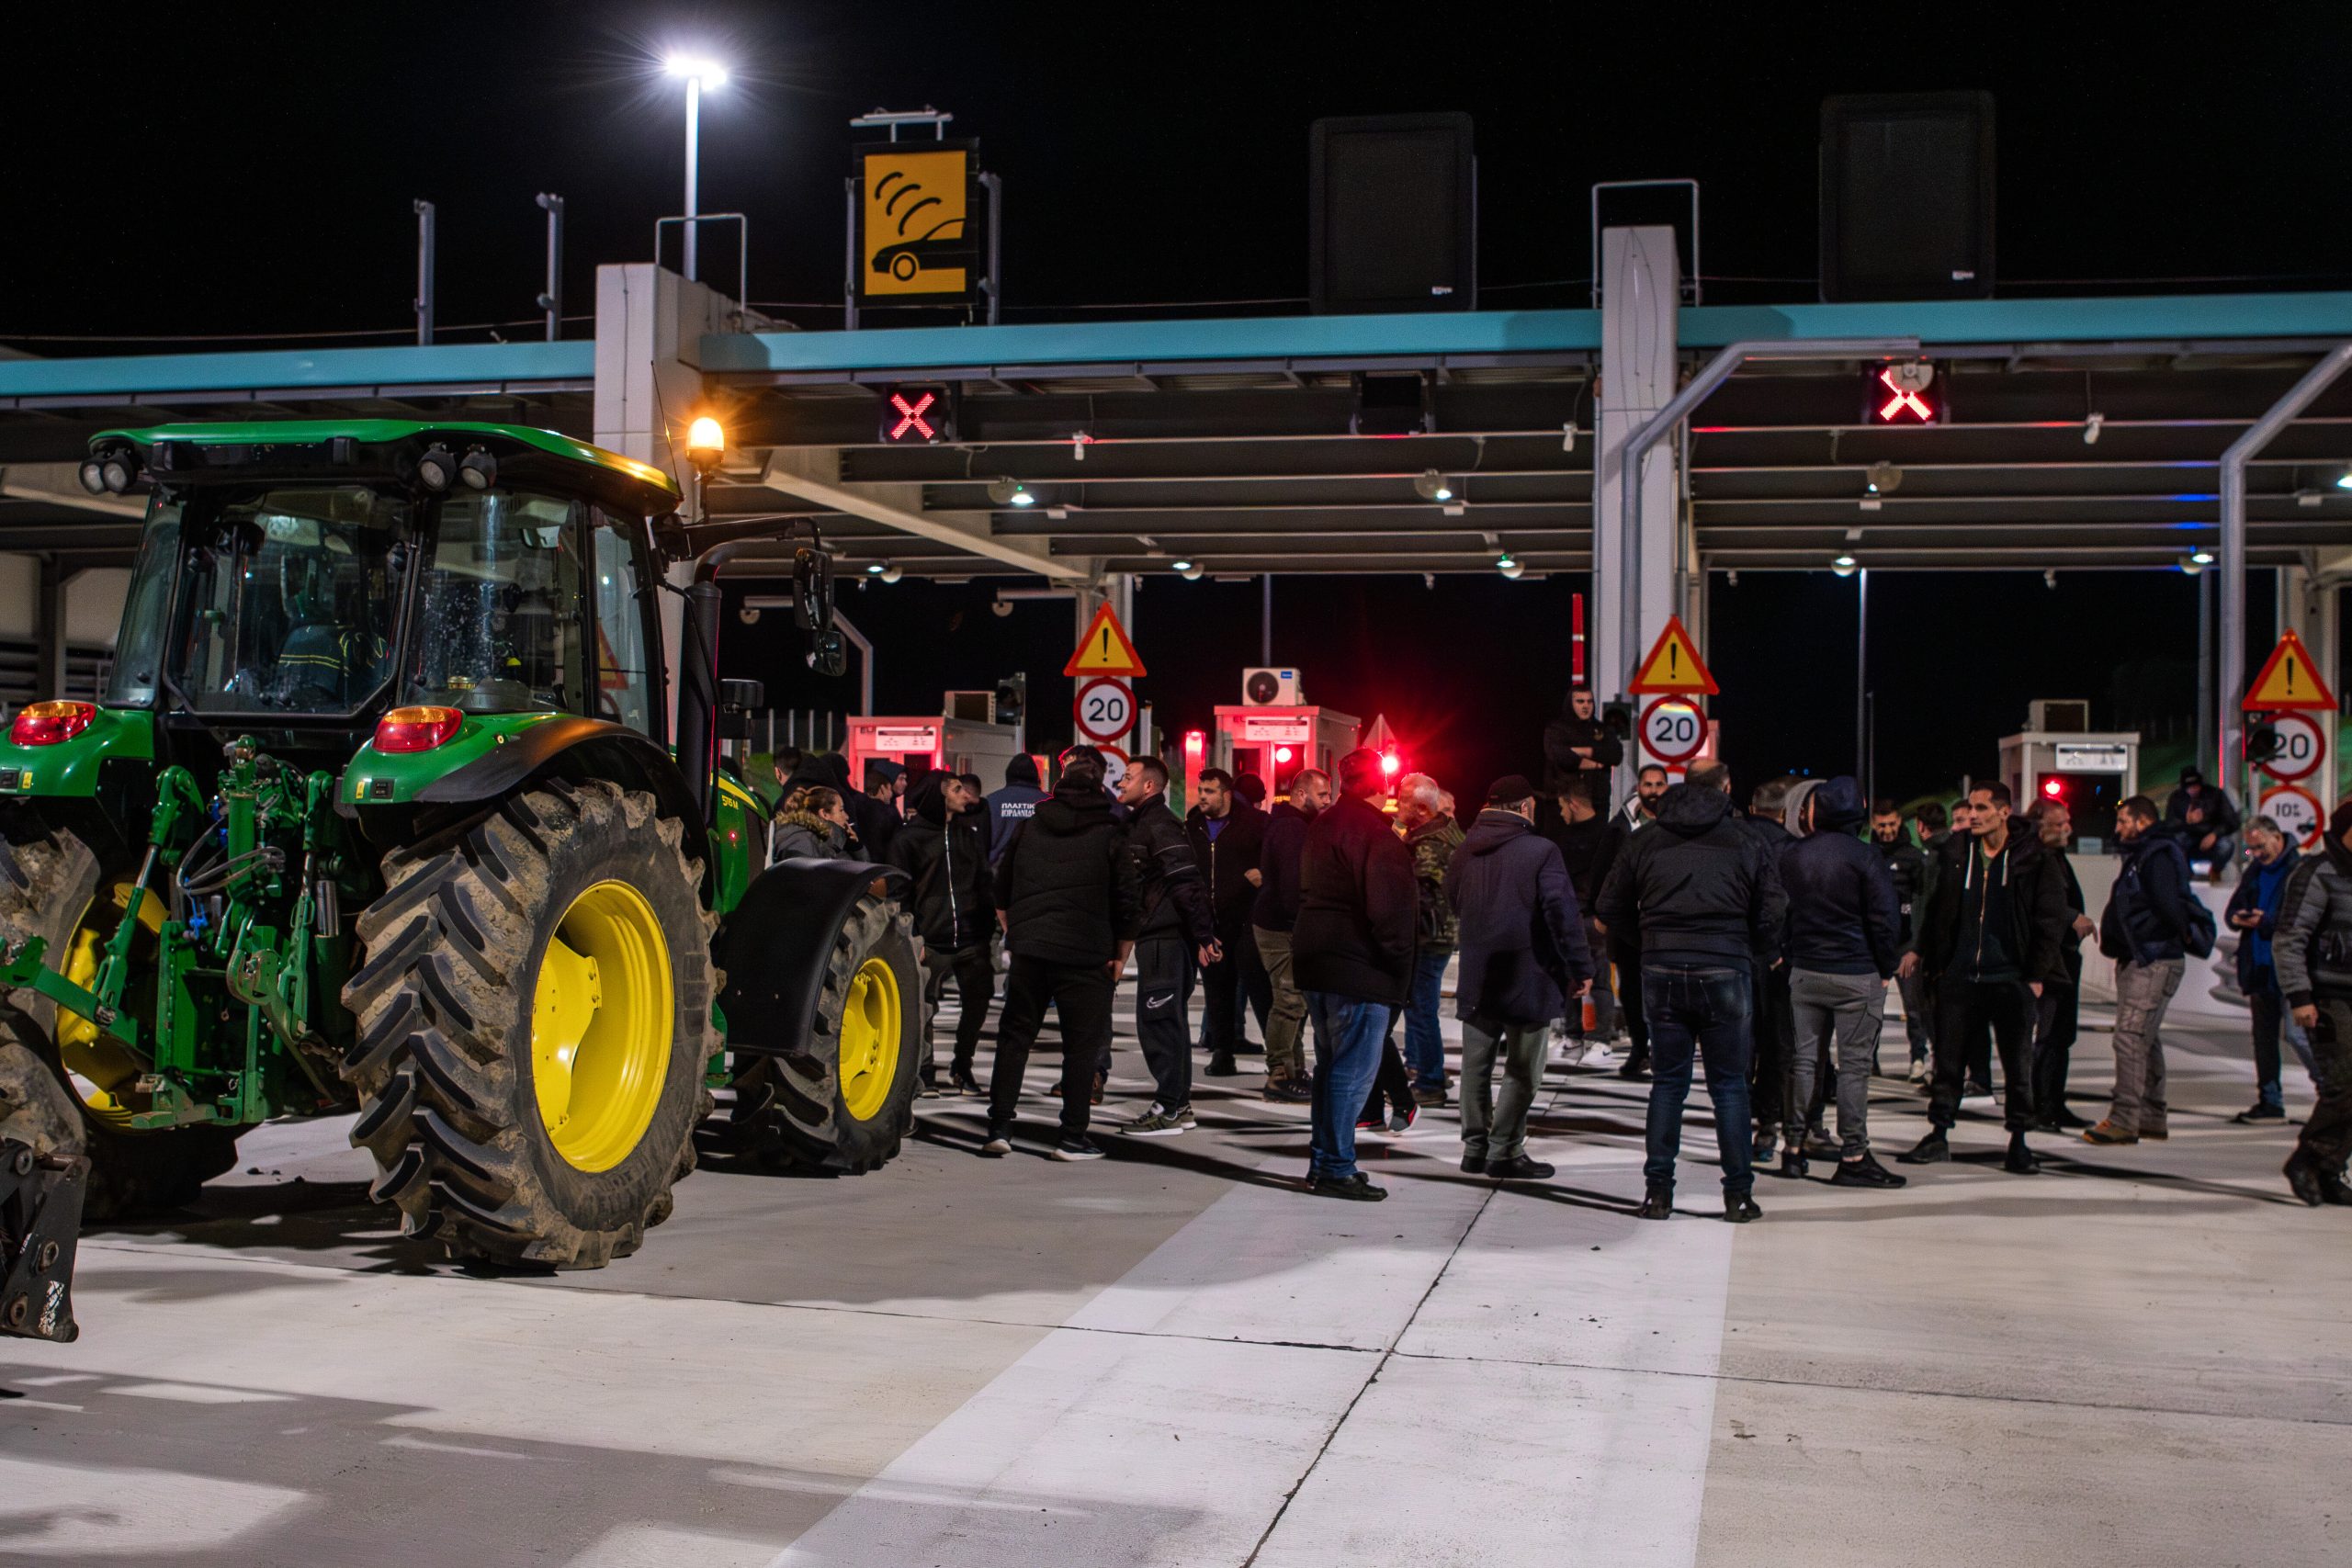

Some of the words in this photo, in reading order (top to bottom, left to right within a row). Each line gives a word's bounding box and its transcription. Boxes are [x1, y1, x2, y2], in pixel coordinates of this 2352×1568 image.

[1088, 698, 1124, 722] 20
[1656, 716, 1693, 741] 20
[2274, 733, 2310, 760] 20
